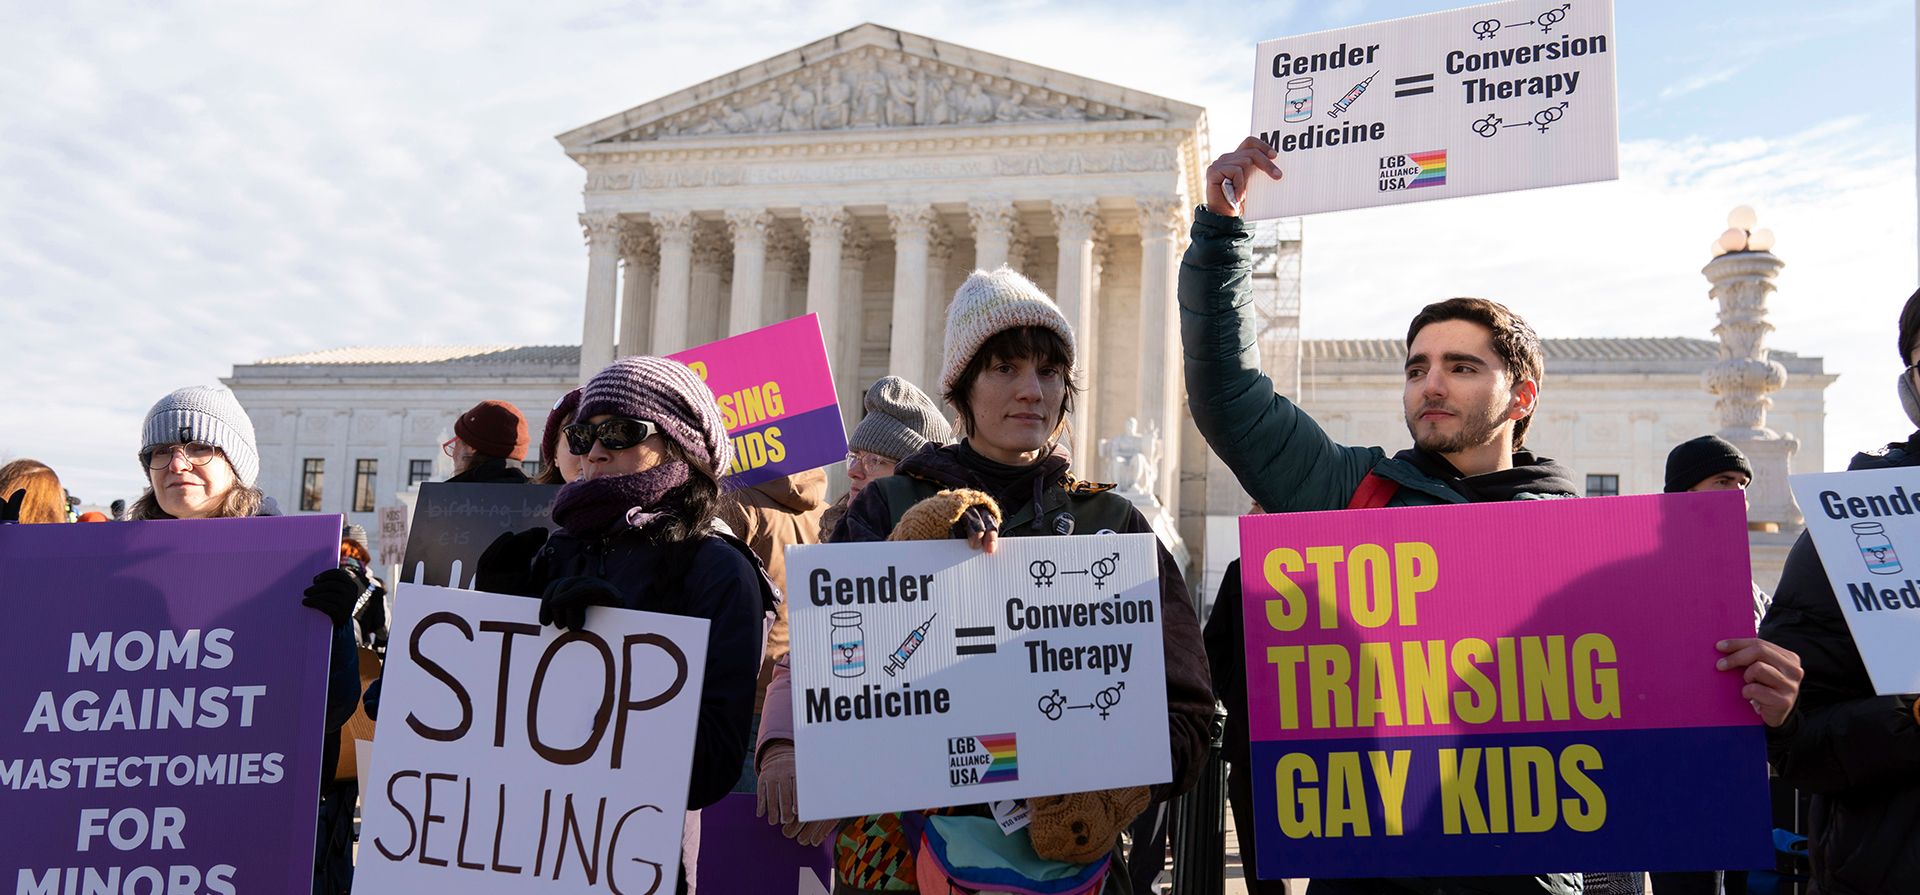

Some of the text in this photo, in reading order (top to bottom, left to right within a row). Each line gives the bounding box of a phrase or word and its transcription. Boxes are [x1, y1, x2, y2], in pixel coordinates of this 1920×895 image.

[1272, 43, 1380, 78] Gender
[1446, 33, 1607, 75] Conversion
[1462, 71, 1581, 104] Therapy
[1261, 120, 1385, 154] Medicine
[1380, 155, 1406, 170] LGB
[1380, 166, 1419, 178] ALLIANCE
[1379, 177, 1406, 191] USA
[809, 566, 934, 606] Gender
[1263, 542, 1438, 631] STOP
[1006, 594, 1154, 631] Conversion
[67, 629, 235, 673] MOMS
[1025, 640, 1133, 675] Therapy
[405, 611, 688, 770] STOP
[1267, 633, 1621, 730] TRANSING
[24, 685, 266, 733] AGAINST
[806, 683, 950, 723] Medicine
[948, 737, 976, 755] LGB
[950, 754, 990, 767] ALLIANCE
[0, 752, 285, 790] MASTECTOMIES
[950, 767, 979, 785] USA
[1275, 743, 1607, 839] GAY KIDS
[77, 806, 186, 852] FOR
[373, 770, 663, 895] SELLING
[16, 864, 237, 895] MINORS
